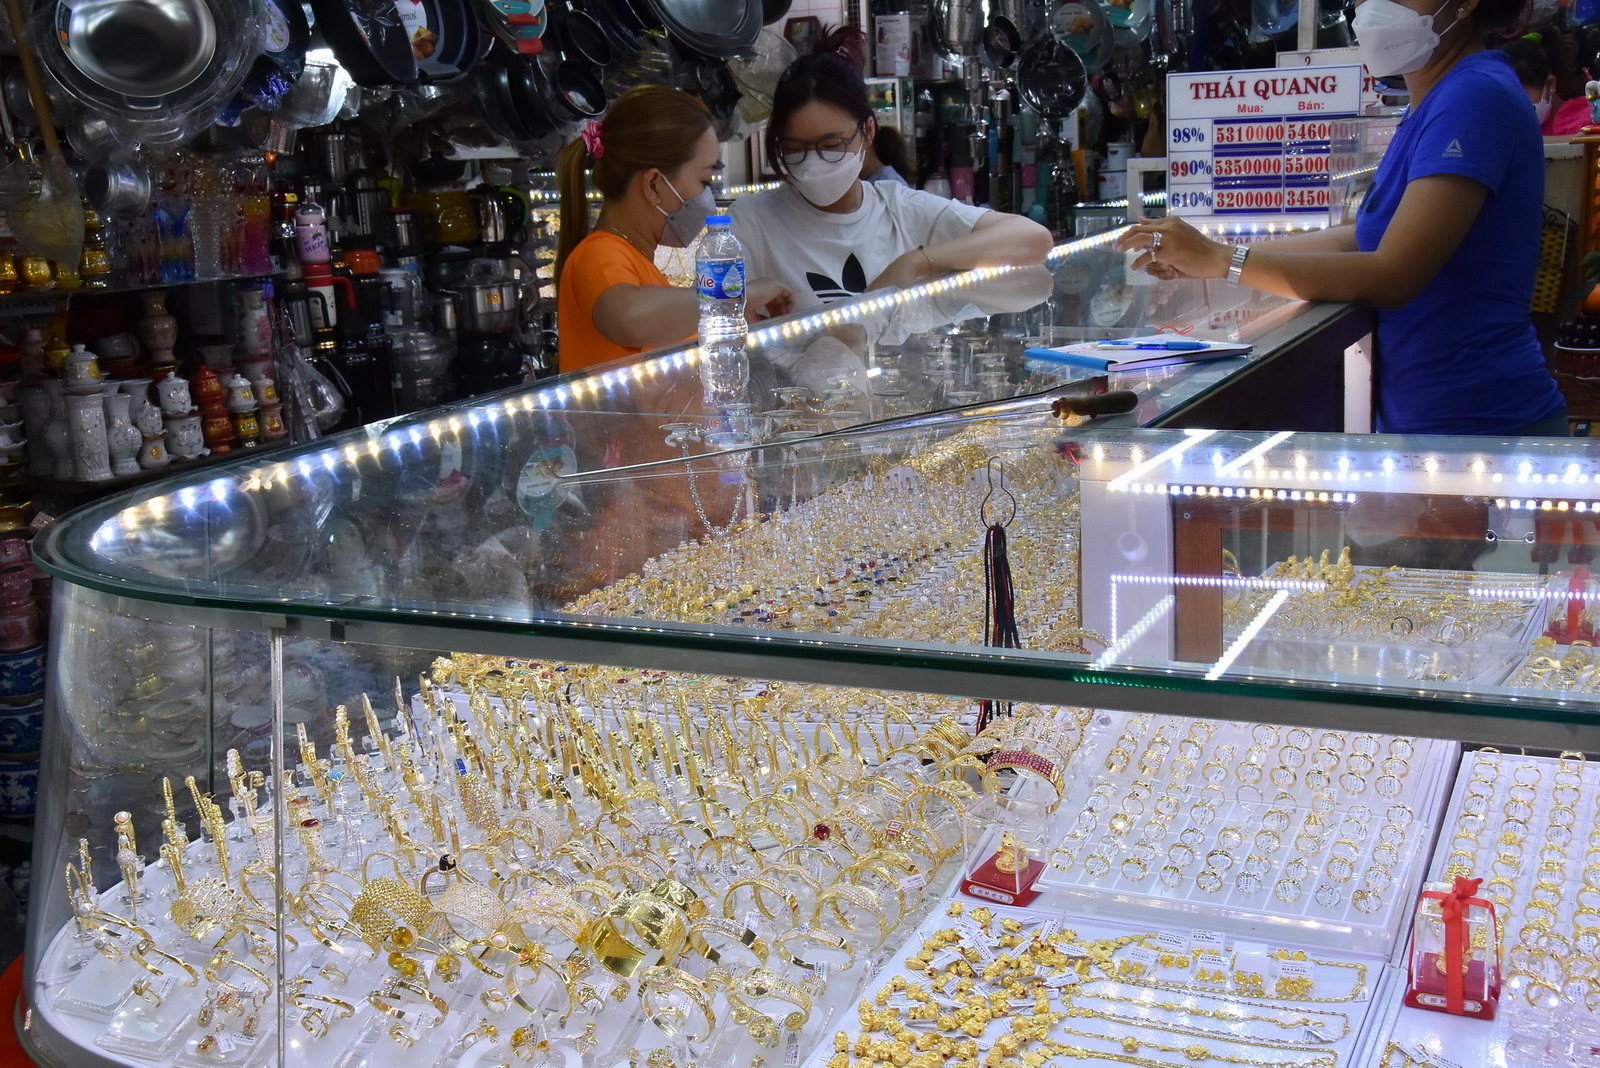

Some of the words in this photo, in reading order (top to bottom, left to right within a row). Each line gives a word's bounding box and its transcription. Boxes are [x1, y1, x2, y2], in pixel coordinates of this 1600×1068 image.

[1190, 75, 1247, 99] THÁI
[1253, 75, 1337, 100] QUANG
[1237, 104, 1264, 113] Mua:
[1297, 100, 1324, 111] Bán:
[1172, 127, 1205, 143] 98%
[1216, 124, 1285, 143] 5310000
[1171, 159, 1212, 177] 990%
[1215, 157, 1282, 175] 5350000
[1171, 191, 1212, 208] 610%
[1216, 191, 1283, 208] 3200000
[696, 273, 715, 288] Vie
